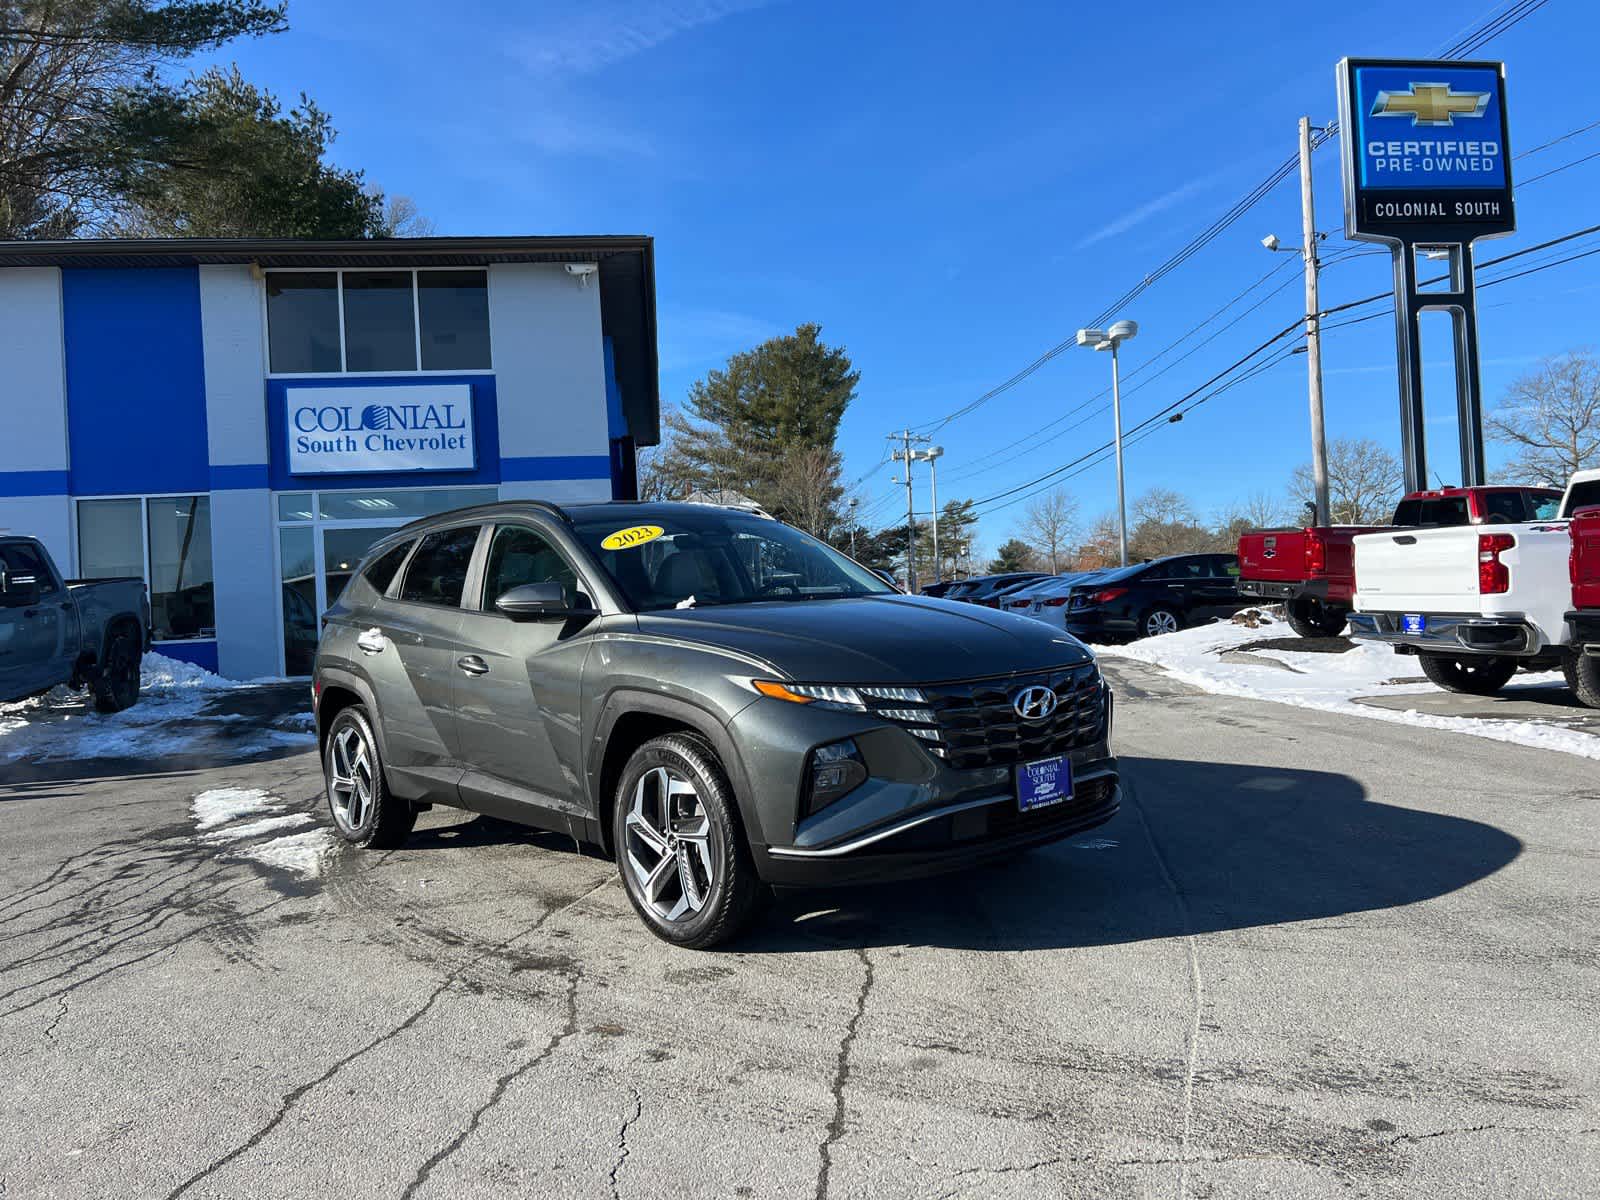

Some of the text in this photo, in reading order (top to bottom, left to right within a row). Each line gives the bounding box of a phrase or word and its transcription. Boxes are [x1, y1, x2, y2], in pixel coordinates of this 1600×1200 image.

[1368, 141, 1498, 156] CERTIFIED
[1376, 158, 1494, 172] PRE-OWNED
[1375, 202, 1501, 217] COLONIAL SOUTH
[294, 404, 466, 432] COLONIAL
[296, 433, 467, 453] South Chevrolet
[613, 528, 653, 547] 2023
